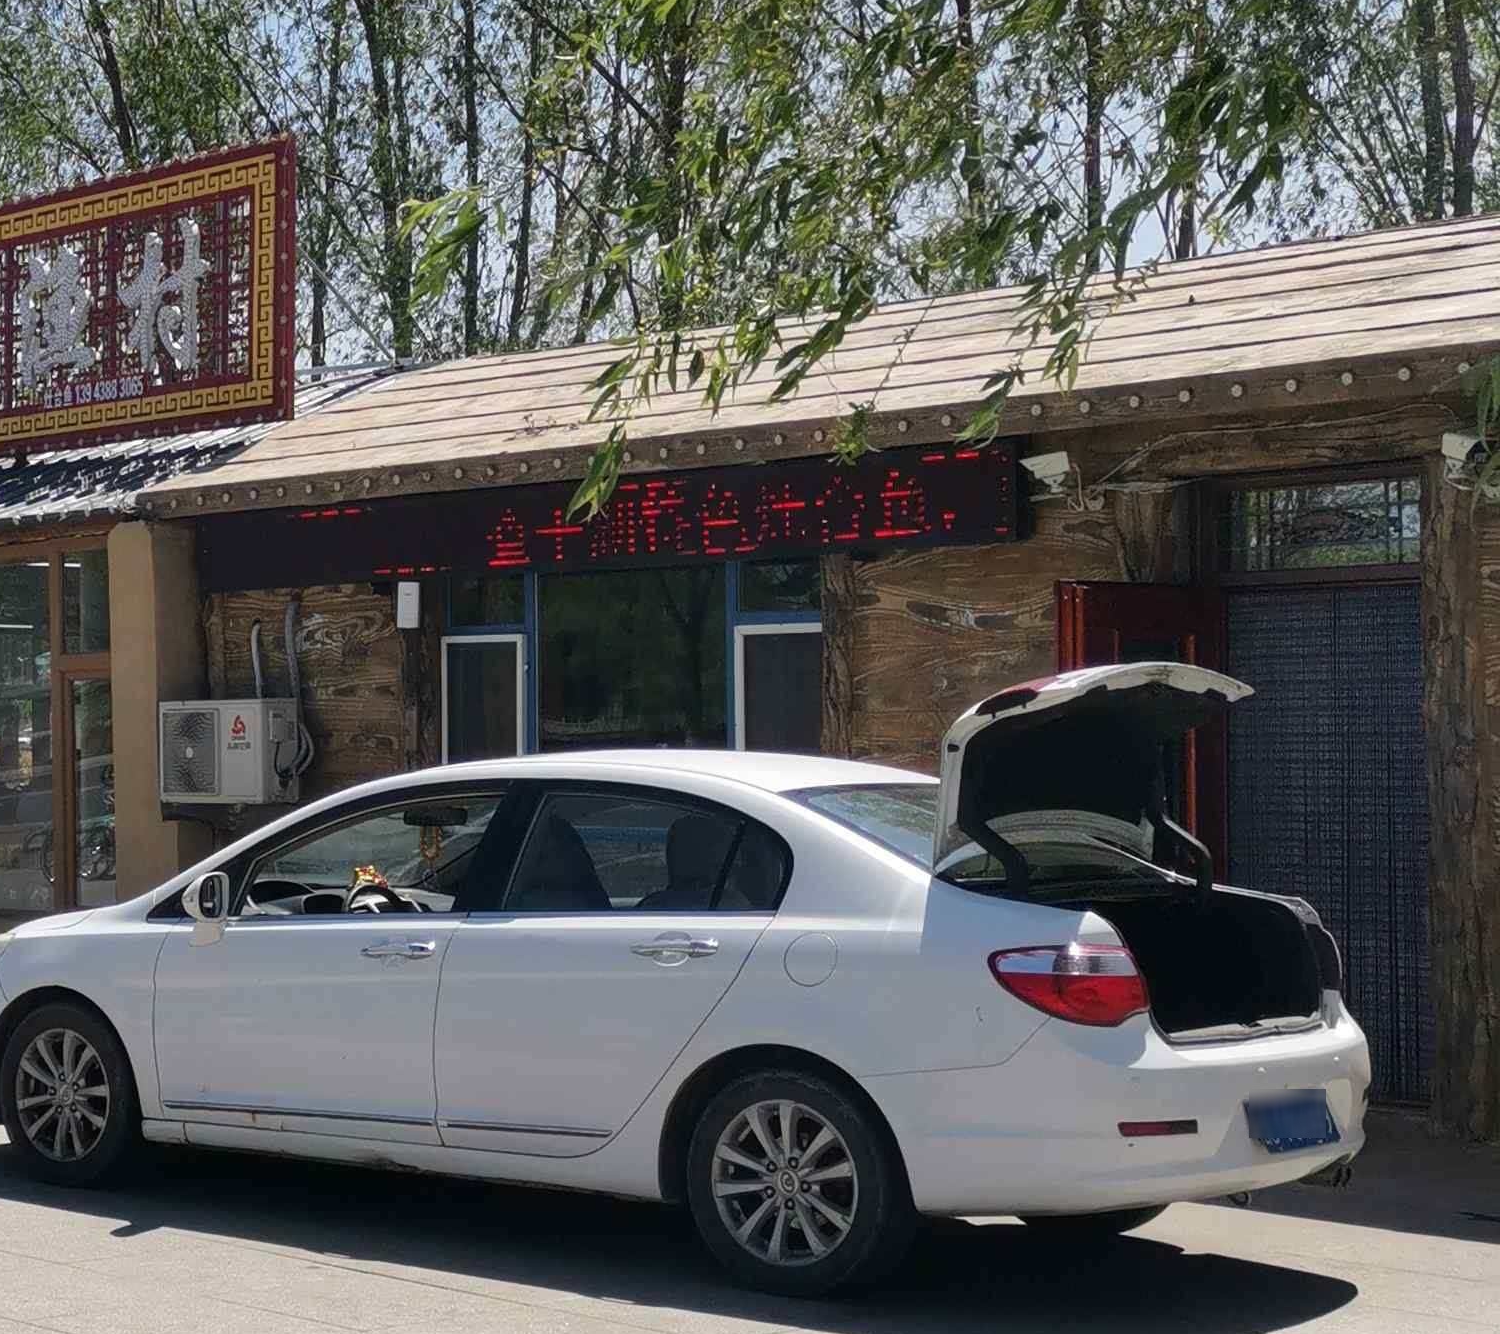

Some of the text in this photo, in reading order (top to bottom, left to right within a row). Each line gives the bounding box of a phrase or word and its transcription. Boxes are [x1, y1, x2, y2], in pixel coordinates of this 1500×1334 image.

[75, 382, 92, 405] 139
[93, 379, 118, 401] 4388
[119, 375, 144, 398] 3065
